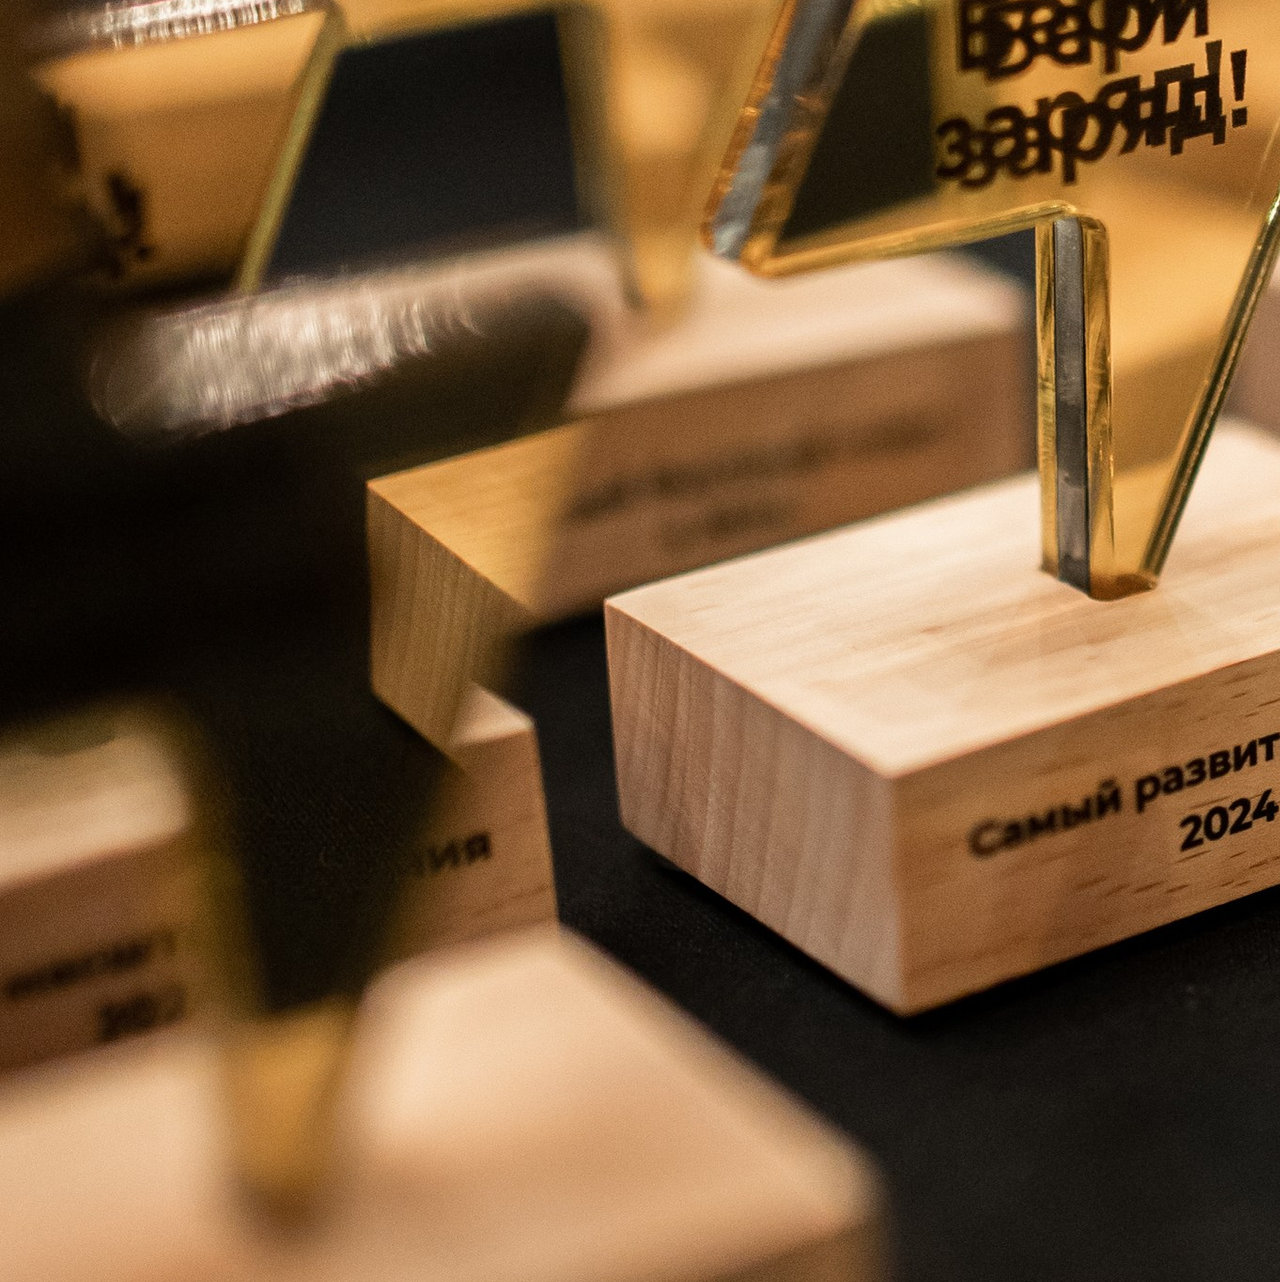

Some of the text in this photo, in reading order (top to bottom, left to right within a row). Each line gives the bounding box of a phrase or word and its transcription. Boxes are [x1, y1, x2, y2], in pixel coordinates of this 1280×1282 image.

[935, 40, 1248, 187] заряд!
[968, 778, 1122, 859] Самый
[1178, 788, 1280, 852] 2024
